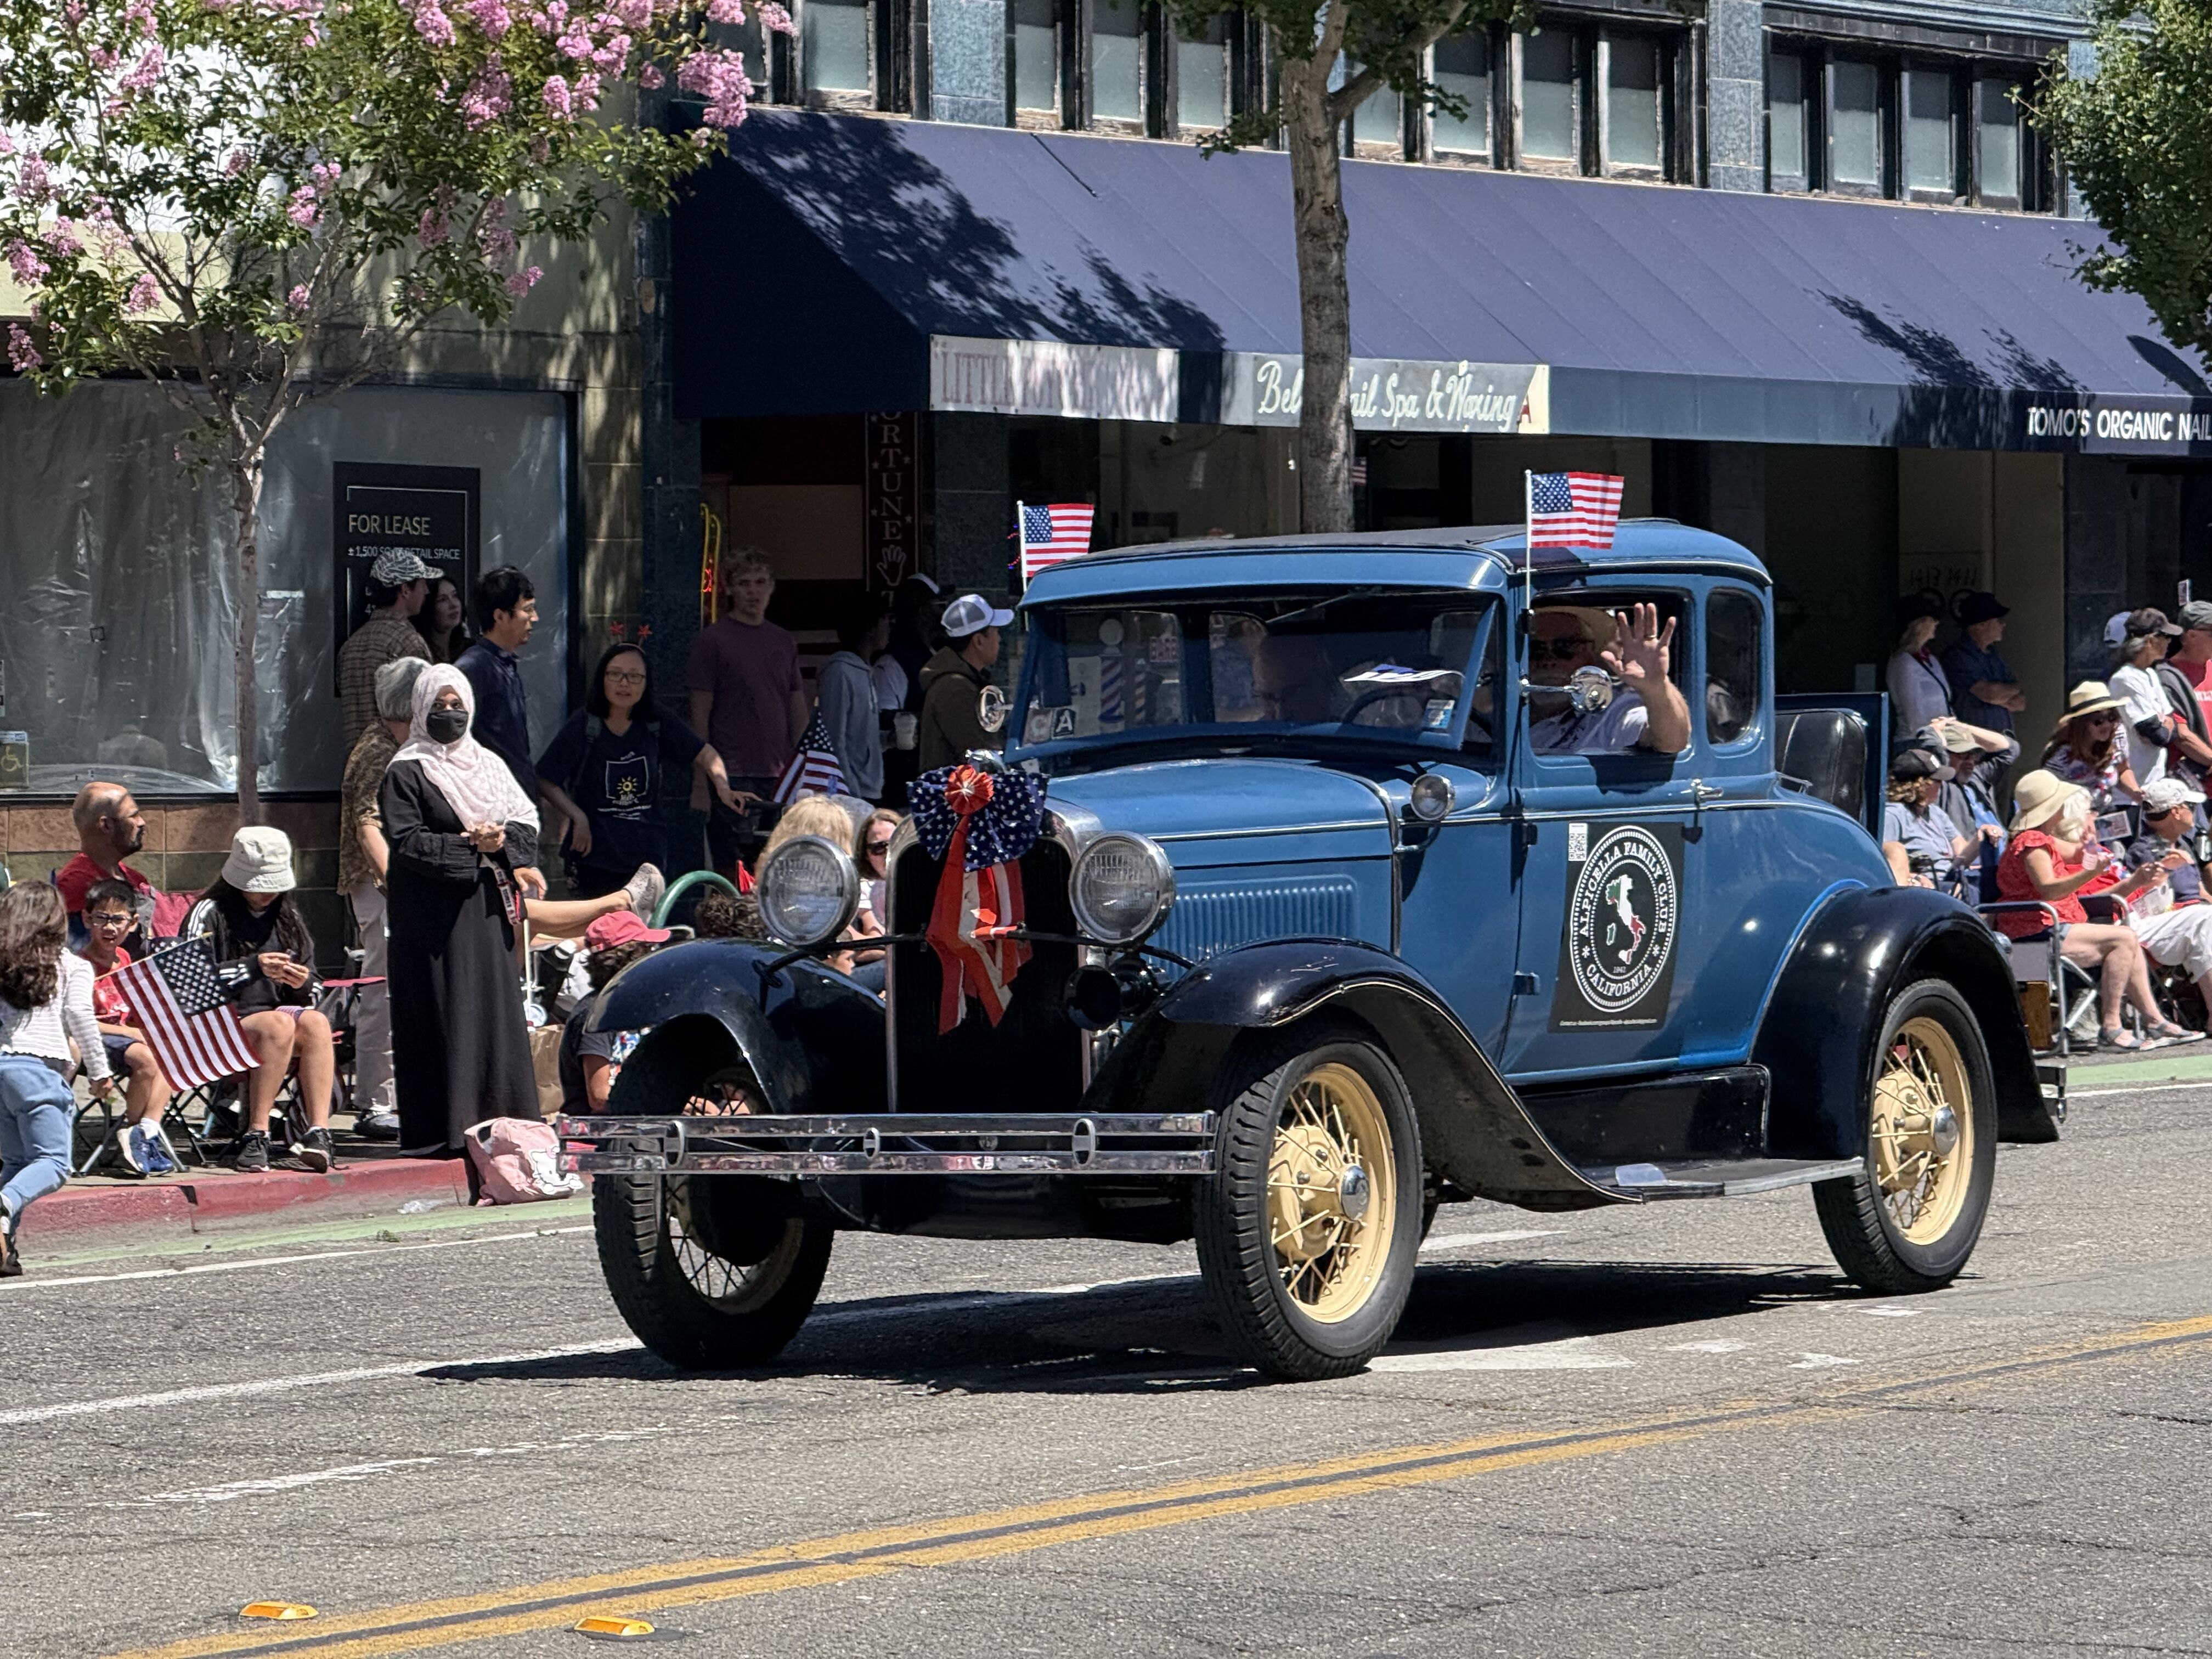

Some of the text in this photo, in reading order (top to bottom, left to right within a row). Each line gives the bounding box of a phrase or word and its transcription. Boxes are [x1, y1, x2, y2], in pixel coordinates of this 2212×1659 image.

[1381, 373, 1420, 427] Spa
[1426, 369, 1444, 419] &
[1446, 374, 1517, 433] Waxing
[2028, 407, 2091, 437] TOMO'S
[2097, 409, 2174, 441] ORGANIC
[348, 515, 431, 535] FOR LEASE
[356, 546, 378, 557] 1,500
[433, 549, 461, 560] SPACE
[1056, 710, 1073, 733] A
[1580, 842, 1669, 937] ALPICELLA FAMILY CLUB
[1586, 964, 1652, 997] CALIFORNIA
